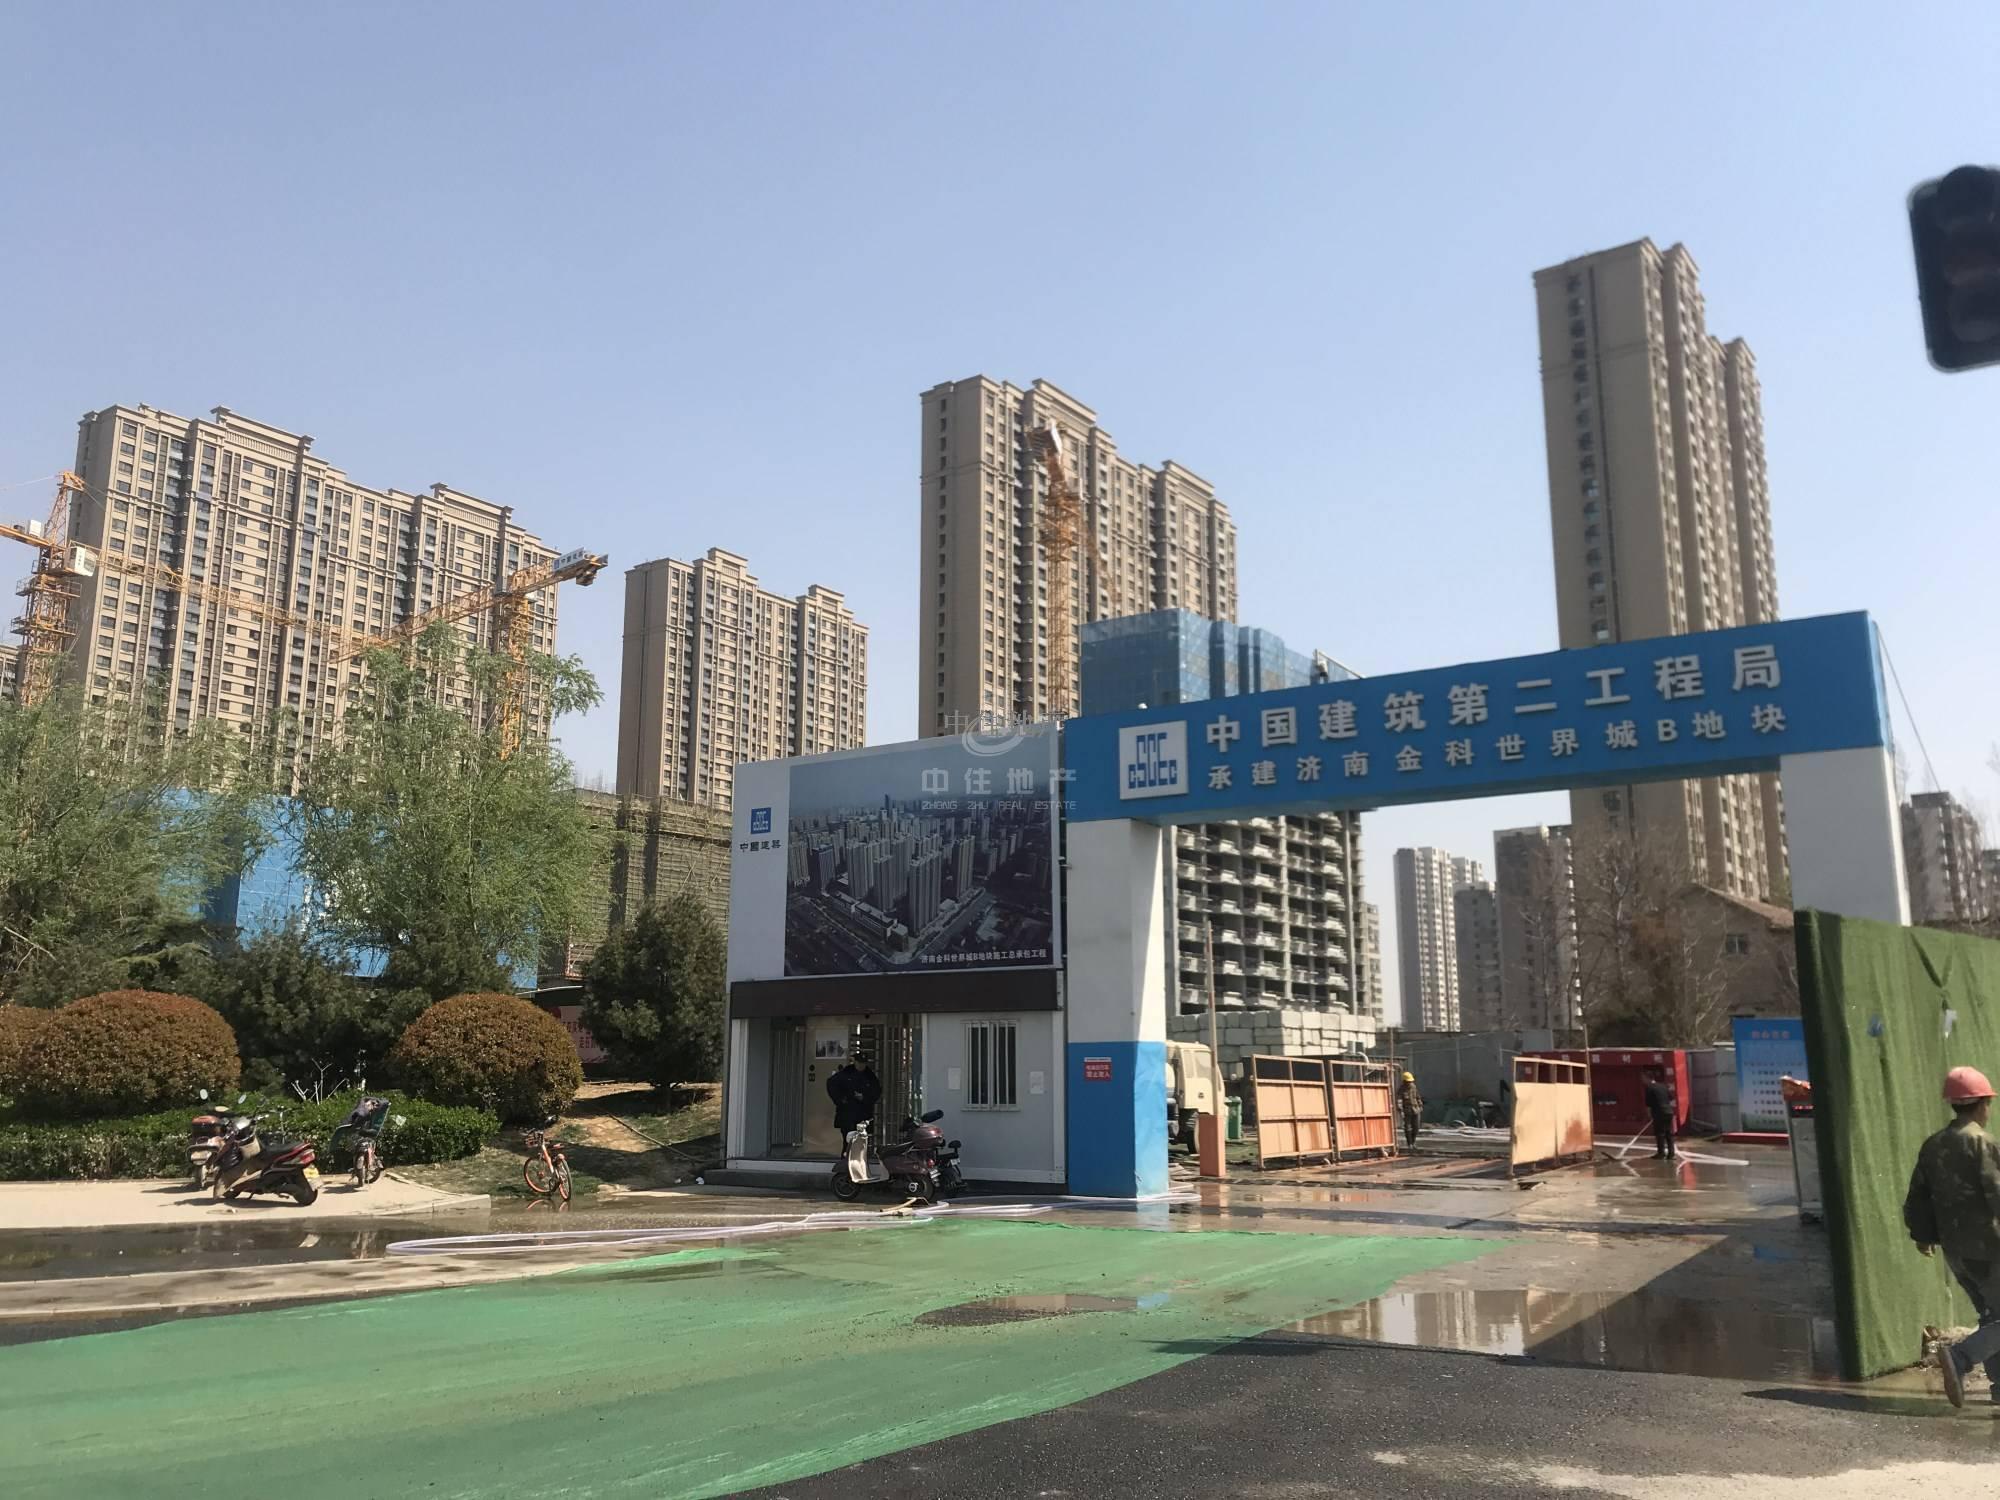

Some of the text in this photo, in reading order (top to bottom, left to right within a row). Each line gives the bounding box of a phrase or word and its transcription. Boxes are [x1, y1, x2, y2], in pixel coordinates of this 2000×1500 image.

[1206, 644, 1781, 752] 中国建筑第二工程局
[1208, 704, 1785, 790] 承建济南金科世界城B地块
